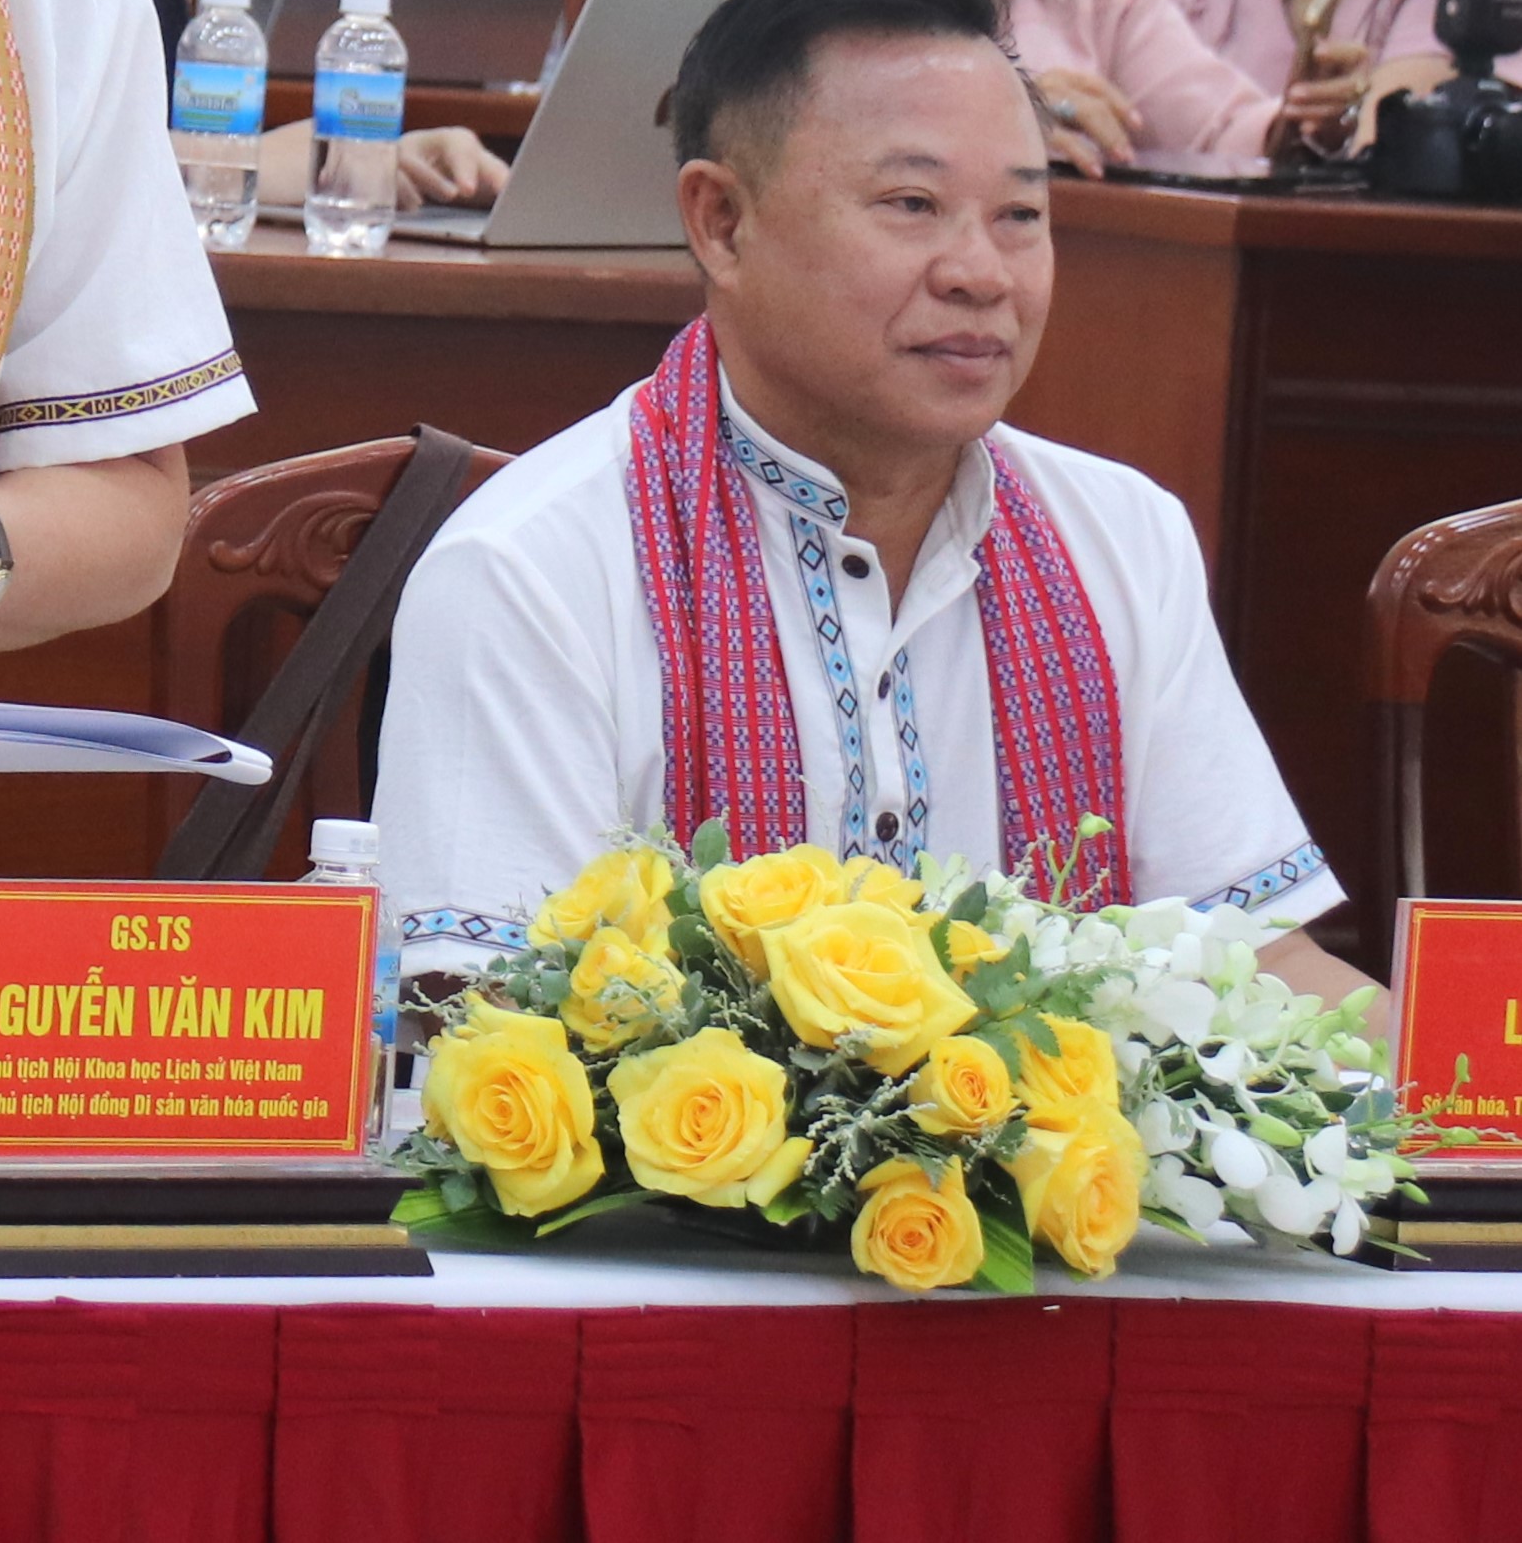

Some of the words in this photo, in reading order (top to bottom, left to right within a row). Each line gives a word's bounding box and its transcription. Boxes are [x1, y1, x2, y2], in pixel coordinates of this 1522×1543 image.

[111, 915, 192, 951] GS.TS
[148, 976, 232, 1038] VĂN
[243, 988, 324, 1040] KIM
[17, 1058, 49, 1082] tịch
[53, 1057, 81, 1082] Hội
[85, 1057, 126, 1079] Khoa
[130, 1059, 162, 1082] học
[165, 1059, 201, 1083] Lịch
[205, 1060, 226, 1080] sử
[230, 1059, 261, 1084] Việt
[264, 1060, 303, 1081] Nam
[22, 1094, 53, 1119] tịch
[57, 1094, 85, 1117] Hội
[89, 1092, 130, 1118] đồng
[134, 1094, 151, 1115] Di
[155, 1095, 185, 1116] sản
[190, 1096, 219, 1116] văn
[224, 1097, 255, 1116] hóa
[259, 1095, 299, 1119] quốc
[303, 1098, 328, 1119] gia
[1477, 1095, 1509, 1118] hóa,
